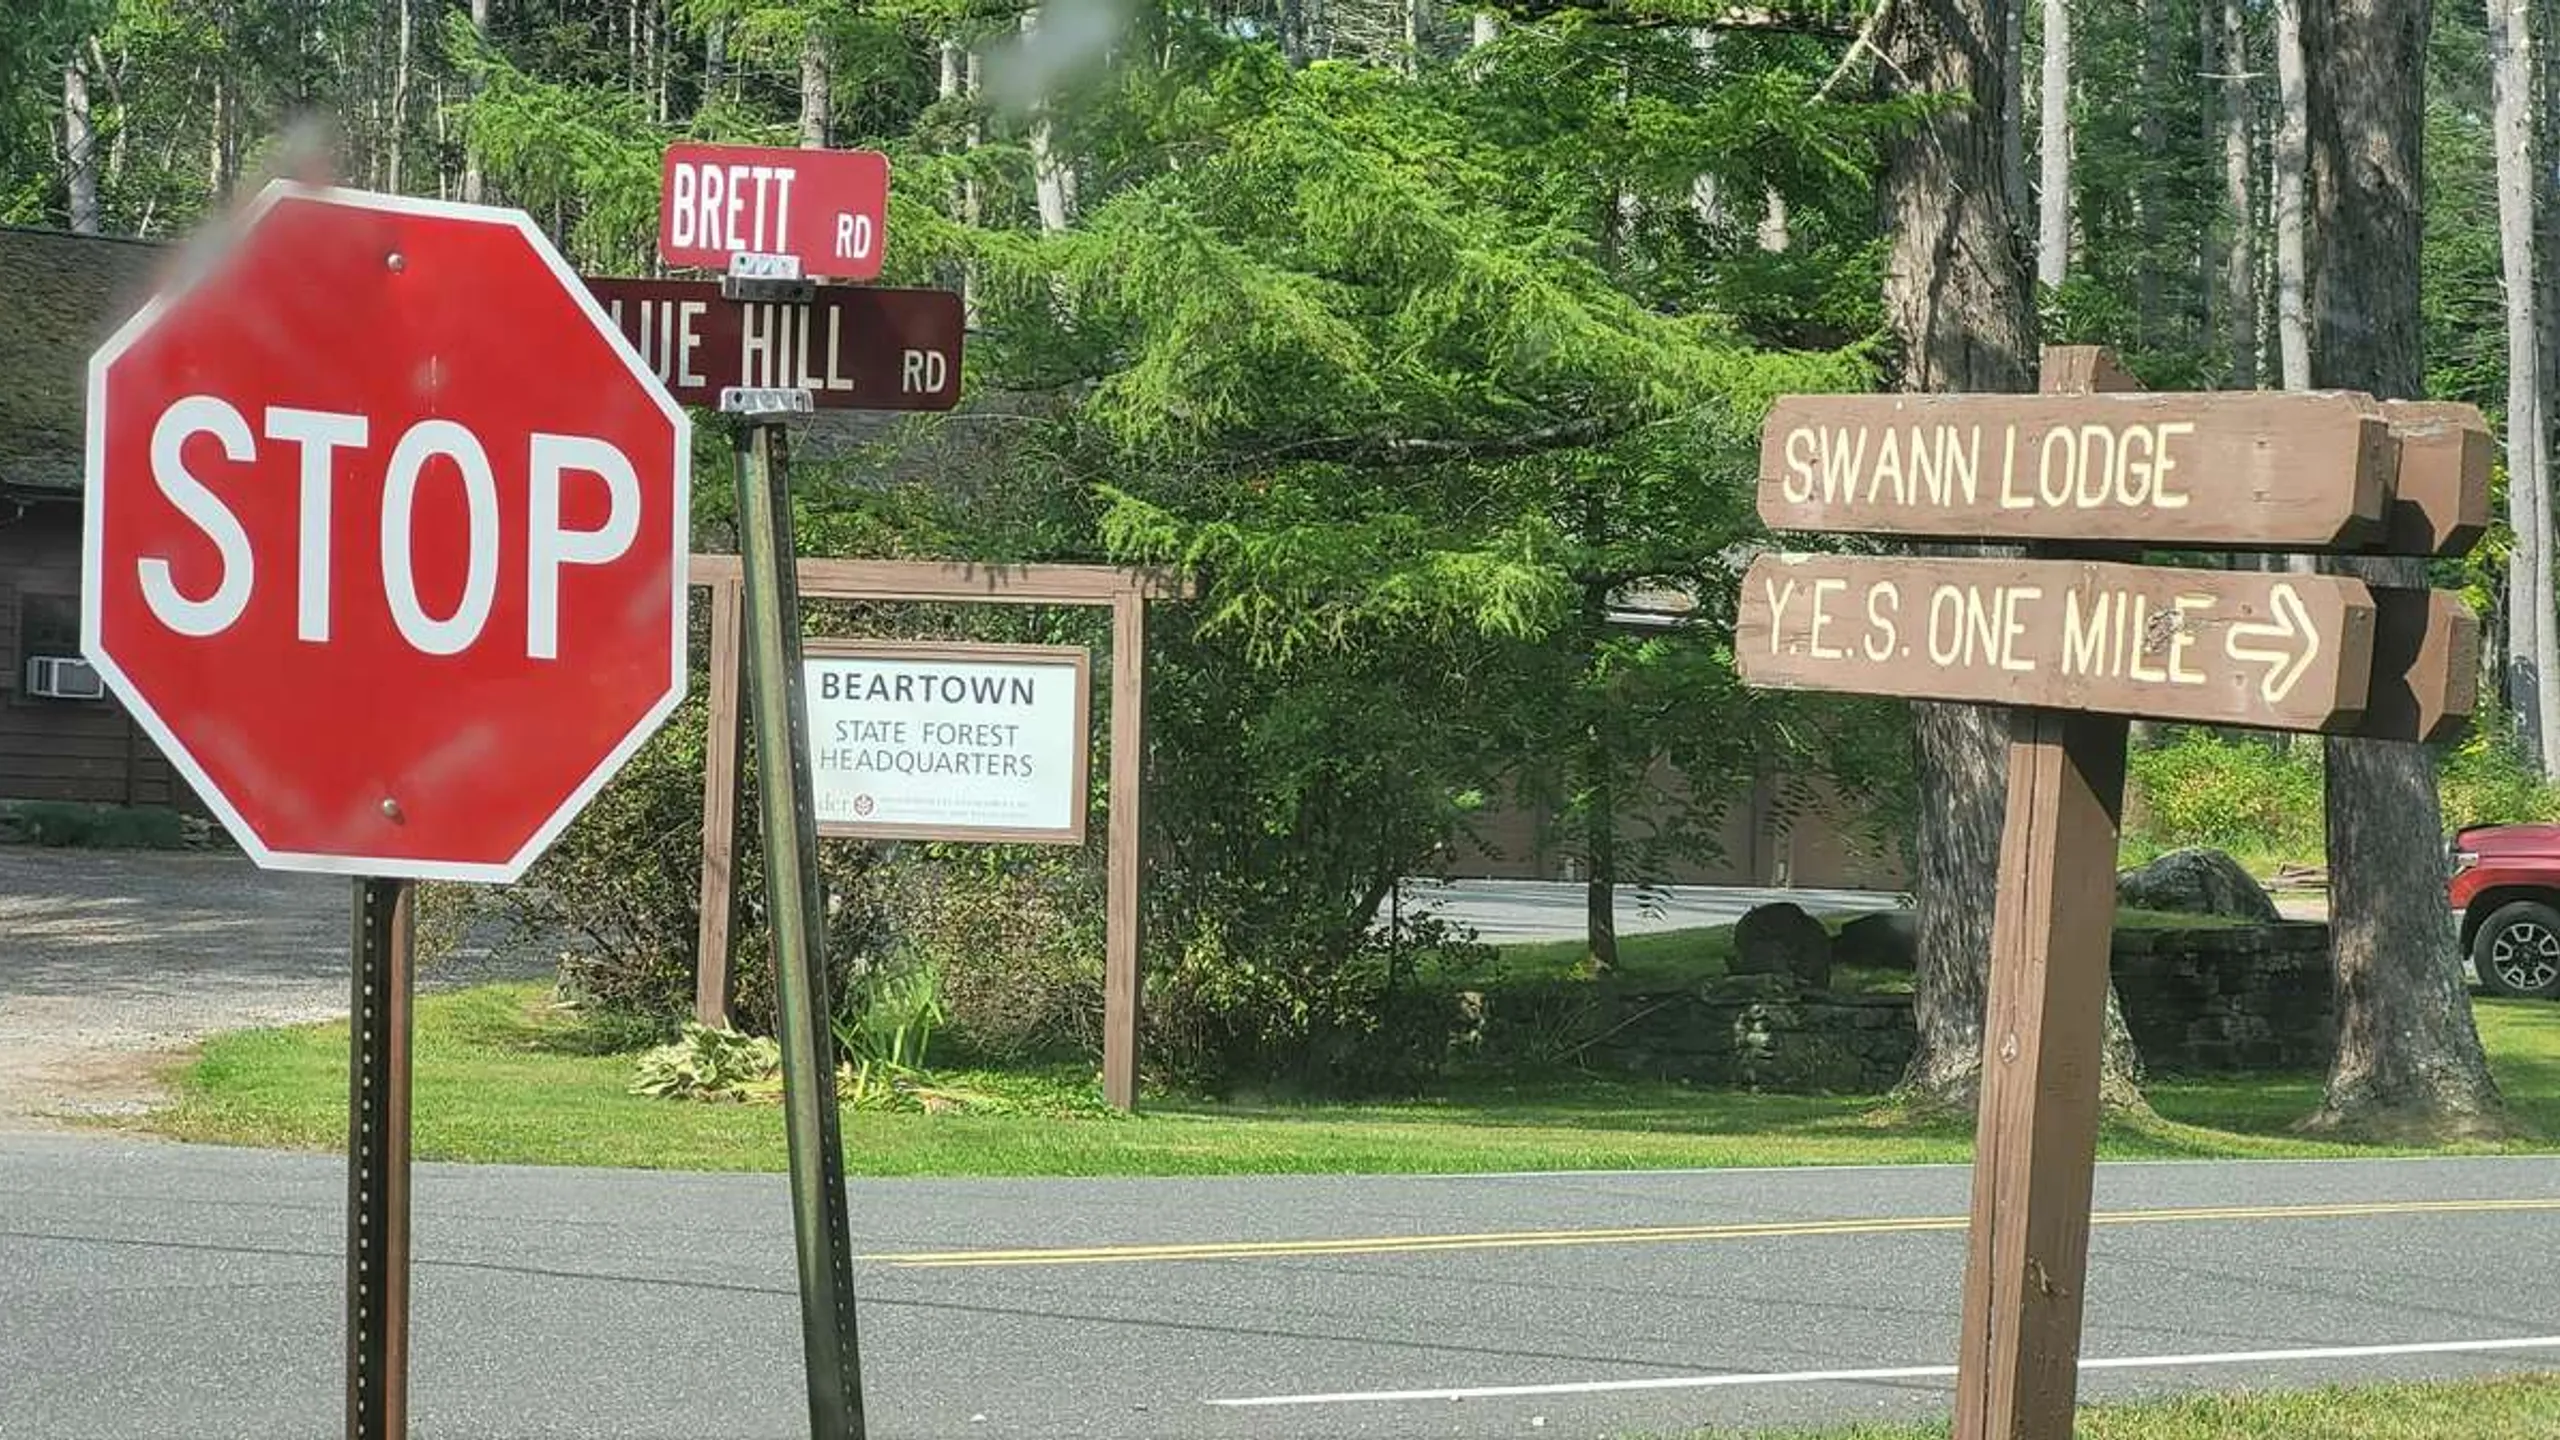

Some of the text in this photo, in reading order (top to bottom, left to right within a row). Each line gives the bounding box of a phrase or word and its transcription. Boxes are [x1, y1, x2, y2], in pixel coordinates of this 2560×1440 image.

[671, 162, 872, 259] BRETT RD
[611, 299, 946, 393] UE HILL RD
[1781, 421, 2195, 509] SWANN LODGE
[137, 394, 641, 660] STOP
[1765, 576, 2218, 684] Y.E.S. ONE MILE
[821, 671, 1035, 706] BEARTOWN
[834, 719, 1020, 748] STATE FOREST
[819, 747, 1034, 778] HEADQUARTERS
